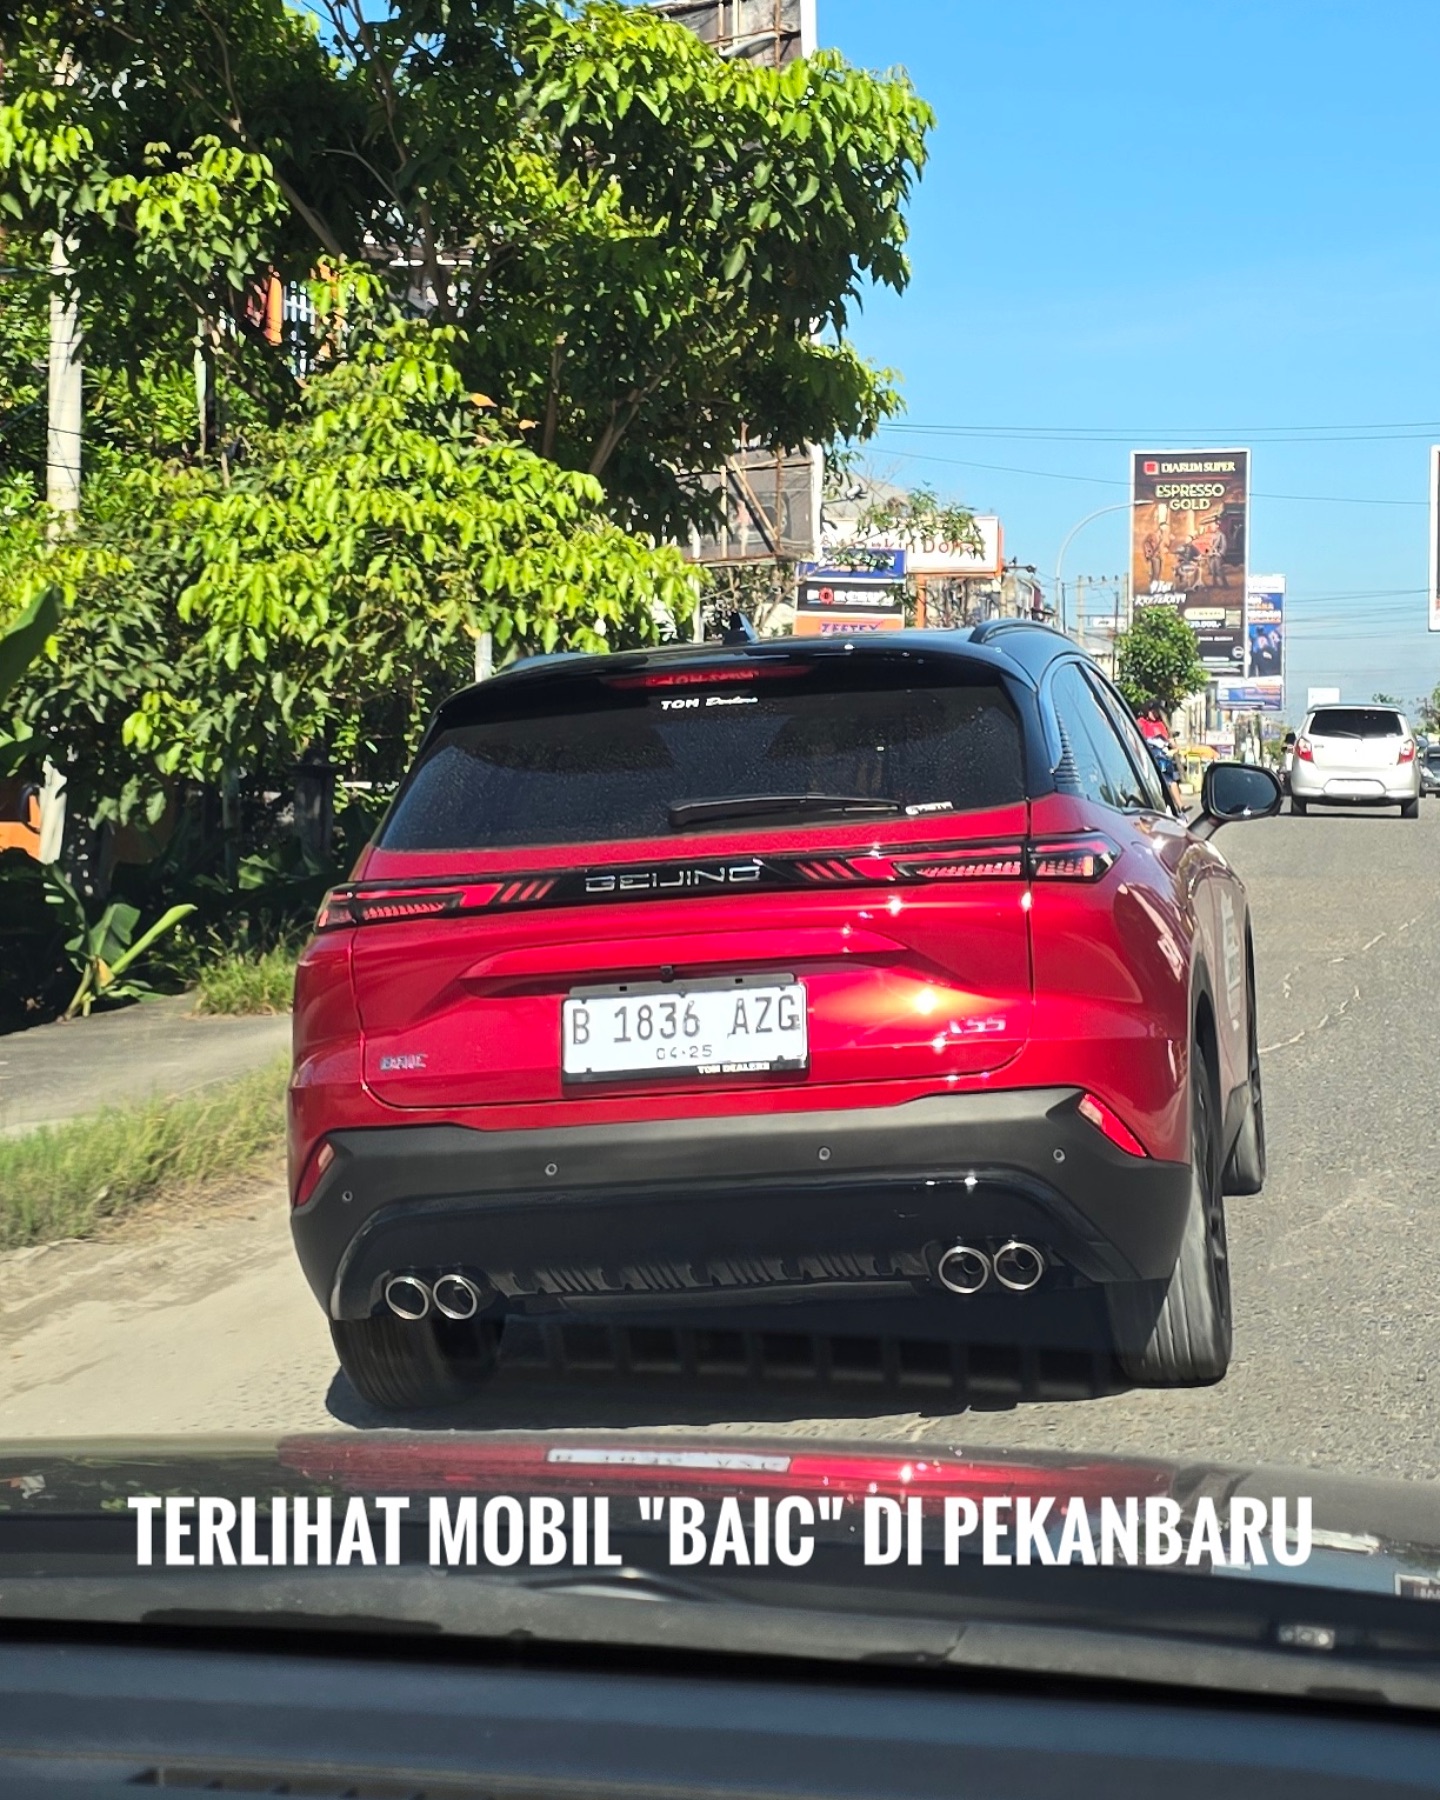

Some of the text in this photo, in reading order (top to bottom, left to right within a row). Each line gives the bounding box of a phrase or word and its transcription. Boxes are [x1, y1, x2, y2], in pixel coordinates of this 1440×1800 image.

[1204, 461, 1236, 472] SUPER
[1155, 483, 1225, 498] ESPRESSO
[1169, 499, 1211, 511] GOLD
[572, 994, 799, 1045] B 1836 AZG
